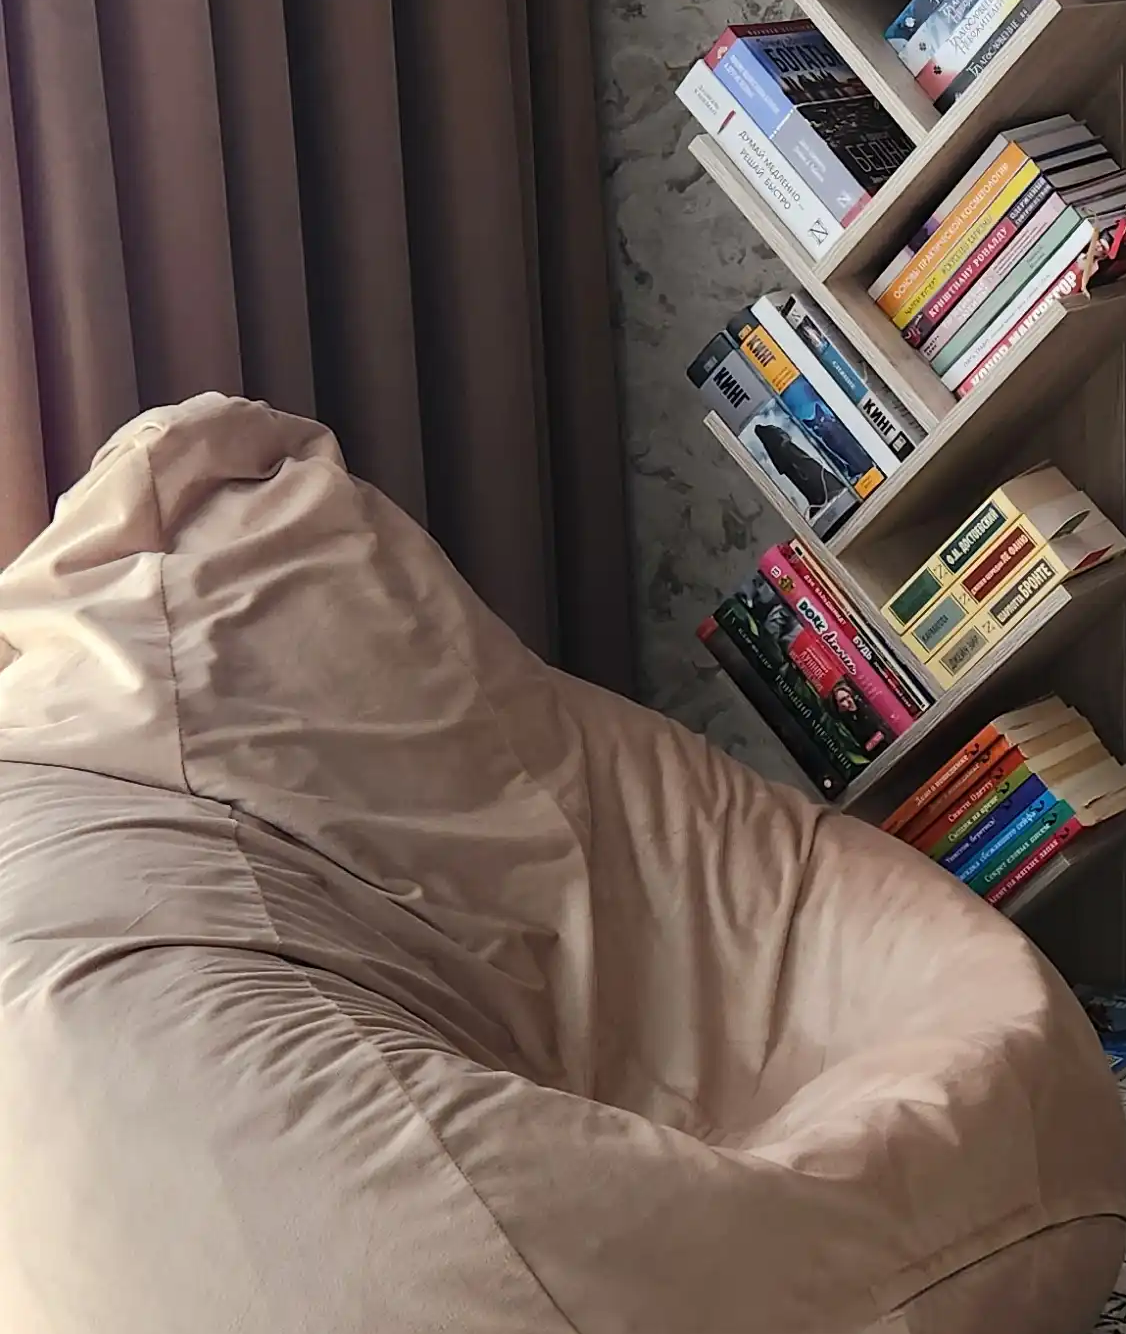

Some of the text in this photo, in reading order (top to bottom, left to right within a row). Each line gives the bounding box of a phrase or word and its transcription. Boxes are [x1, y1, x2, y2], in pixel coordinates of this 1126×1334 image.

[737, 147, 767, 179] РЕШАЙ
[761, 176, 794, 210] БЫСТРО
[891, 159, 1012, 301] ОСНОВЫ КОСМЕТОЛОГИИ
[925, 261, 977, 319] КРИШТИАНУ
[971, 225, 1010, 269] РОНАЛДУ
[744, 333, 778, 370] КИНГ
[709, 365, 752, 411] КИНГ
[859, 396, 898, 439] КИНГ
[955, 507, 1001, 554] ДОСТОЕВСКИЙ
[998, 549, 1013, 565] ЛЕ
[1015, 561, 1053, 599] БРОНТЕ
[795, 599, 863, 676] DORK diaries
[850, 634, 875, 661] БУДЬ
[797, 649, 827, 681] ЛУННОЕ
[946, 777, 995, 824] Спасти Одетту
